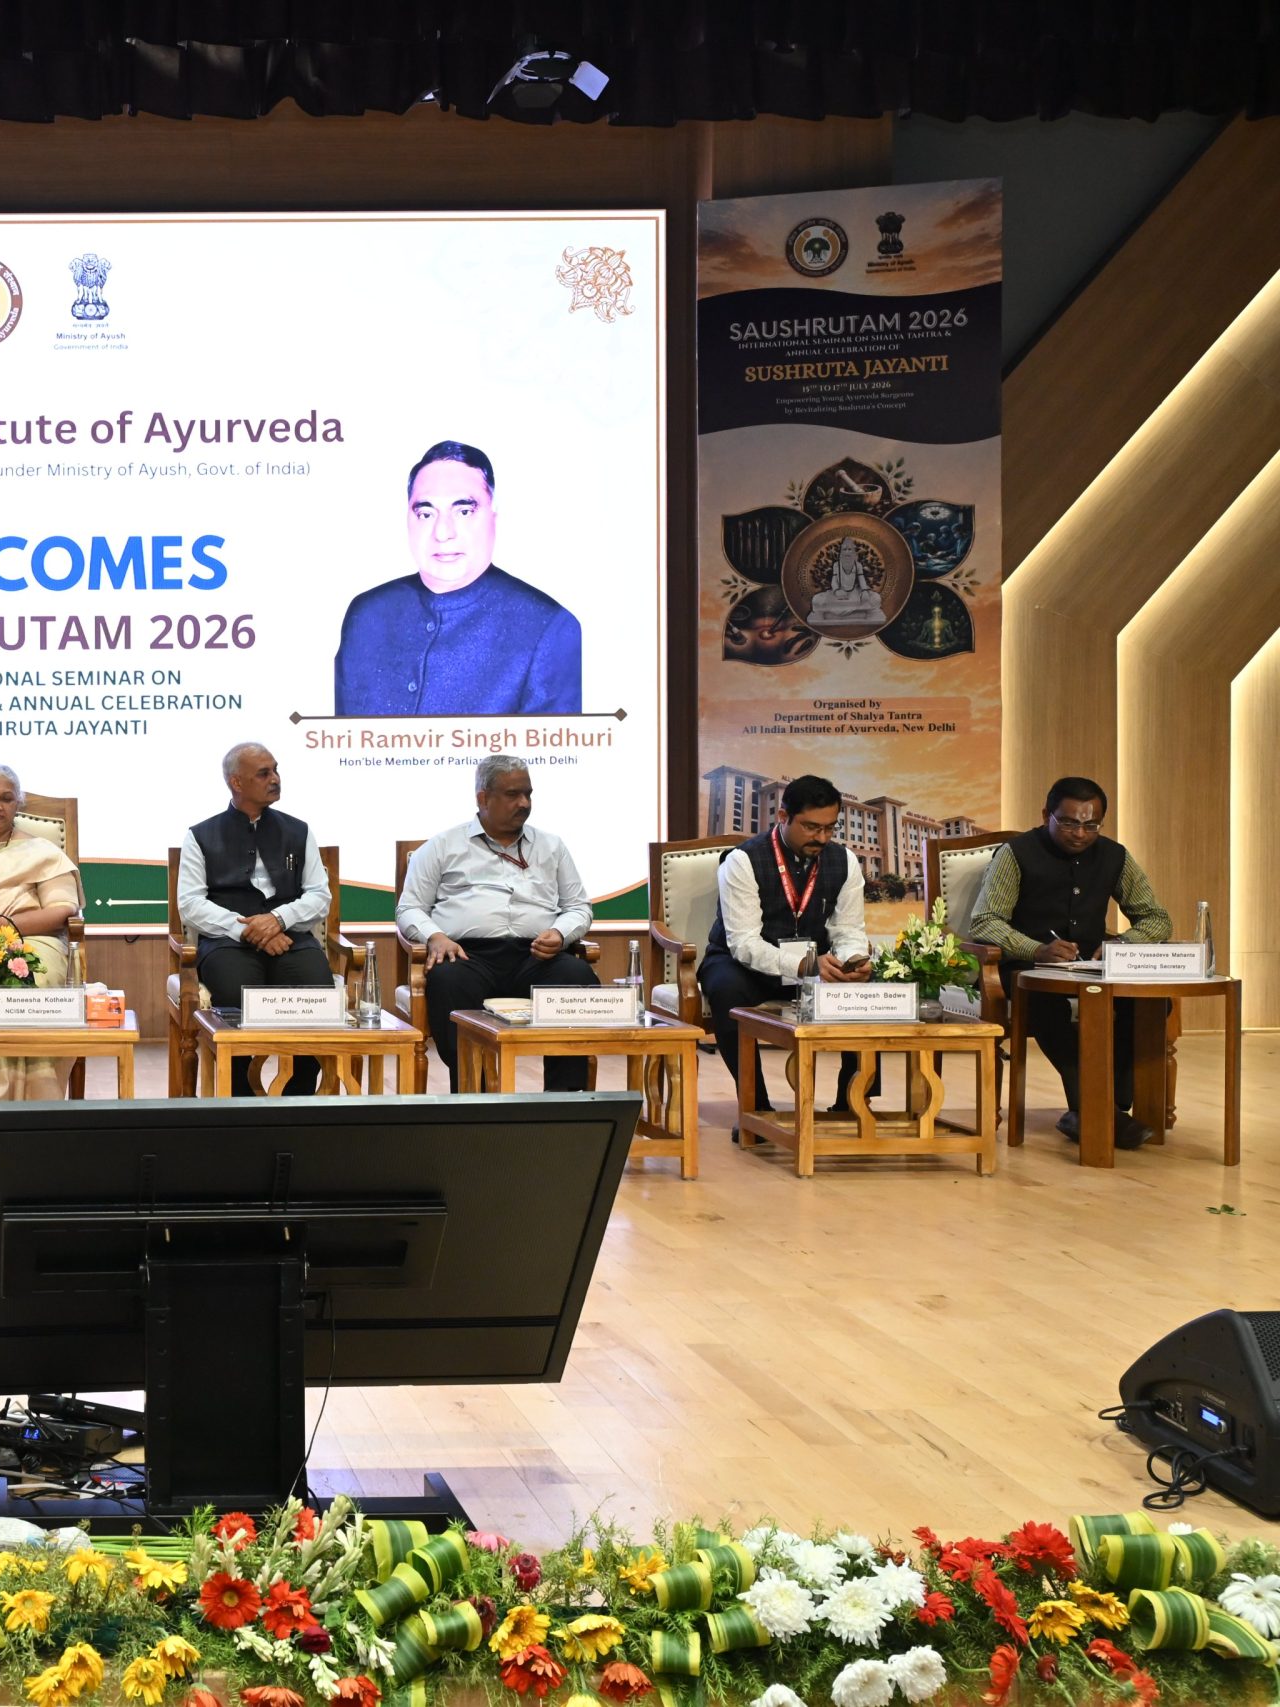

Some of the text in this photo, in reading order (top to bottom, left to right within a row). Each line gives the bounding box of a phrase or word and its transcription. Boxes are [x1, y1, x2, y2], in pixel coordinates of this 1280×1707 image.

[729, 308, 968, 341] SAUSHRUTAM 2026
[56, 332, 126, 340] Ministry of Ayush
[745, 354, 949, 382] SUSHRUTA JAYANTI
[90, 410, 133, 444] of
[144, 410, 344, 453] Ayurveda
[48, 463, 111, 479] Ministry
[117, 462, 134, 477] of
[139, 462, 191, 479] Ayush,
[197, 463, 239, 476] Govt.
[245, 462, 262, 476] of
[267, 461, 311, 476] India)
[150, 614, 256, 650] 2026
[52, 670, 145, 686] SEMINAR
[151, 670, 181, 685] ON
[9, 695, 95, 711] ANNUAL
[101, 694, 242, 711] CELEBRATION
[813, 699, 881, 710] Organised by
[774, 711, 922, 723] Department of Shalya Tantra
[64, 720, 147, 735] JAYANTI
[742, 723, 955, 735] All India Institute of Ayurveda, New Delhi
[306, 728, 612, 752] Shri Ramvir Singh Bidhuri
[385, 757, 430, 766] Member
[434, 756, 445, 765] of
[448, 756, 480, 765] Parlia
[550, 756, 578, 765] Delhi
